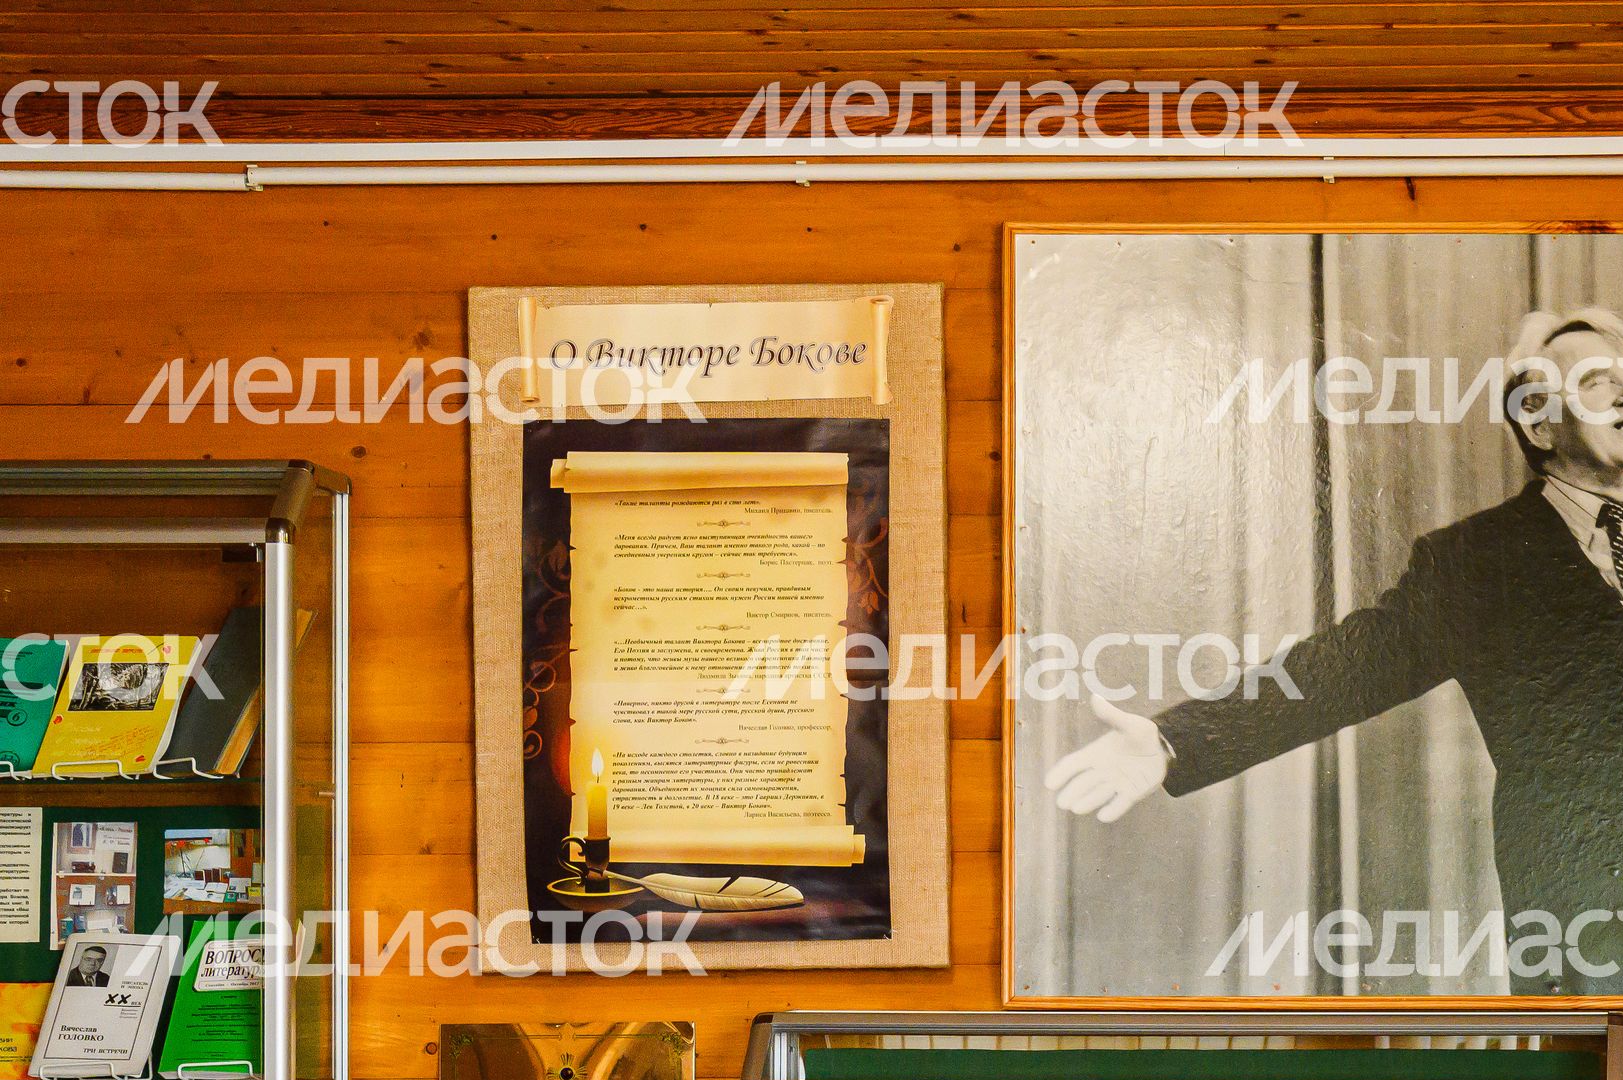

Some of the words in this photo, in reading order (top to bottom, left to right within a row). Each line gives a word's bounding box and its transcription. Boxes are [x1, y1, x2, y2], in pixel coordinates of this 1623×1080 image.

[550, 340, 577, 370] О
[587, 337, 739, 377] Викторе
[750, 336, 867, 370] Бокове
[205, 949, 264, 964] ВОПРОС
[201, 965, 264, 979] литератур
[61, 1025, 97, 1034] Вячеслав
[58, 1034, 104, 1042] ГОЛОВКО
